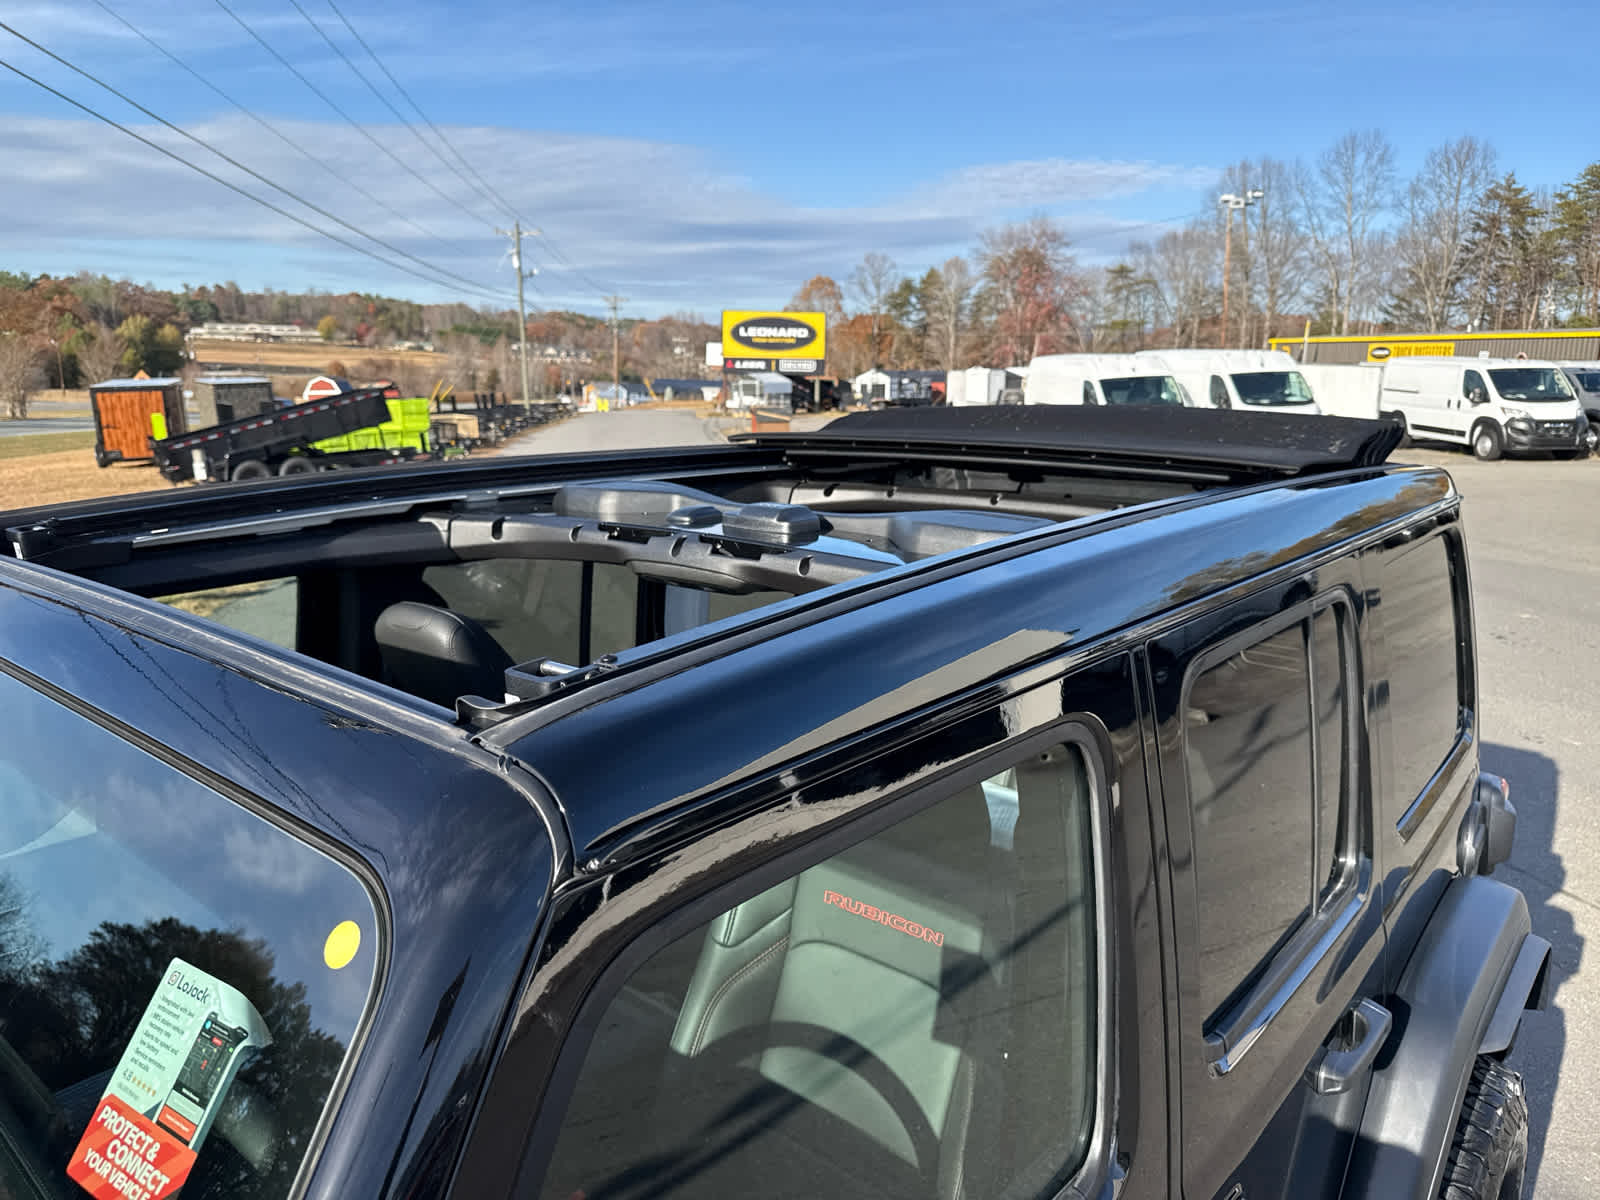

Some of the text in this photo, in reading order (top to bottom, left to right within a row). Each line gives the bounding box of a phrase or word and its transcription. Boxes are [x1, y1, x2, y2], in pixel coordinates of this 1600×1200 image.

[823, 890, 945, 947] RUBICON
[97, 1105, 153, 1155] PROTECT
[146, 1142, 160, 1162] &
[84, 1148, 112, 1179] YOUR
[106, 1139, 170, 1196] CONNECT
